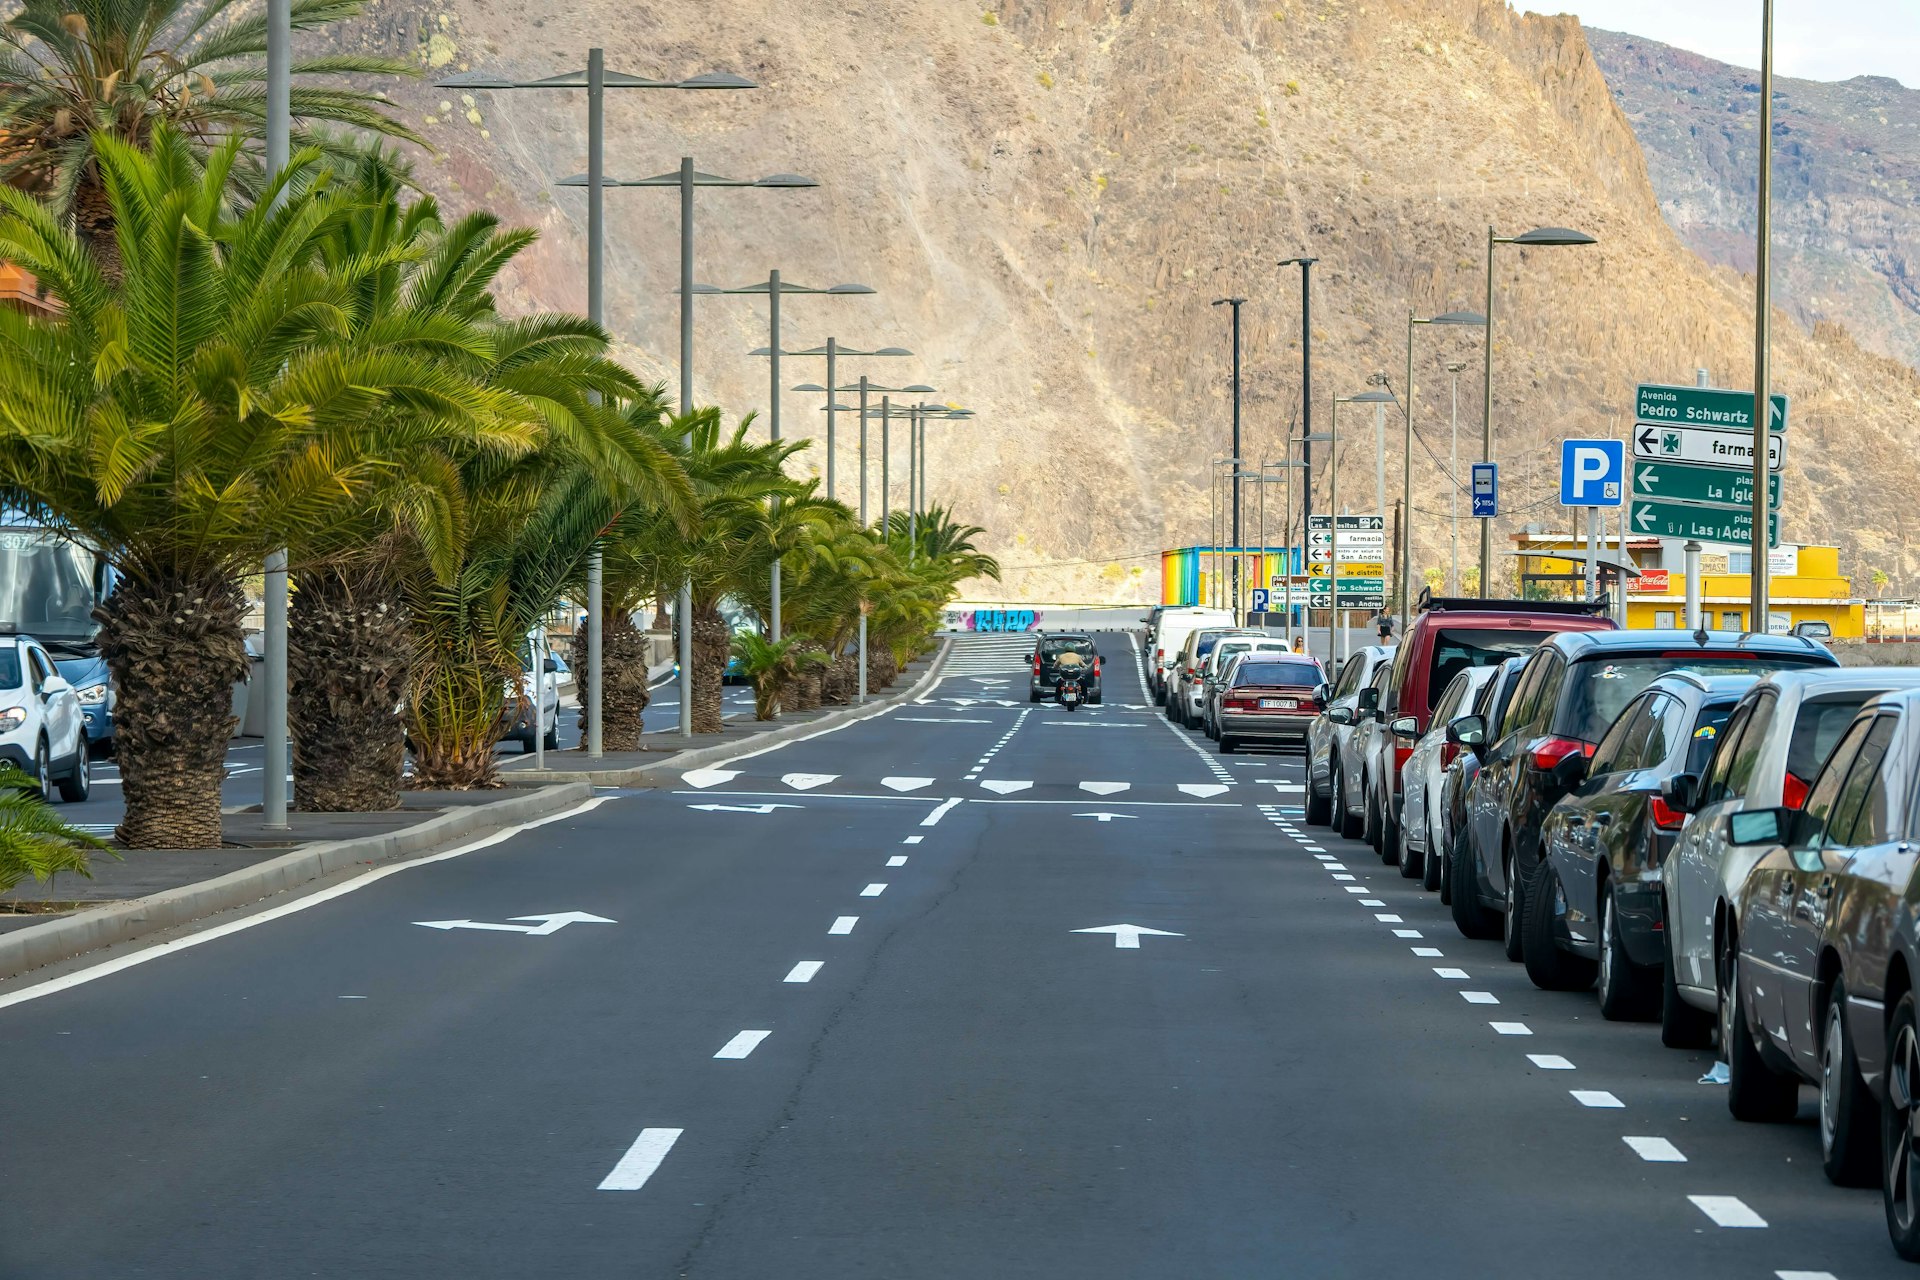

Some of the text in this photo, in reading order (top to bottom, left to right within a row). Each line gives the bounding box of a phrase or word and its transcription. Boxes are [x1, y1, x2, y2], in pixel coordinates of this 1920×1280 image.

[1641, 390, 1676, 402] Avenida
[1640, 403, 1748, 423] Pedro Schwartz
[1712, 440, 1776, 459] farmaa
[1573, 448, 1610, 498] P
[1736, 476, 1754, 486] plaz
[1708, 484, 1774, 504] La Iglea
[1734, 515, 1752, 524] plaz
[1692, 522, 1772, 542] Las Adels
[4, 536, 29, 549] 307
[1254, 591, 1264, 610] P
